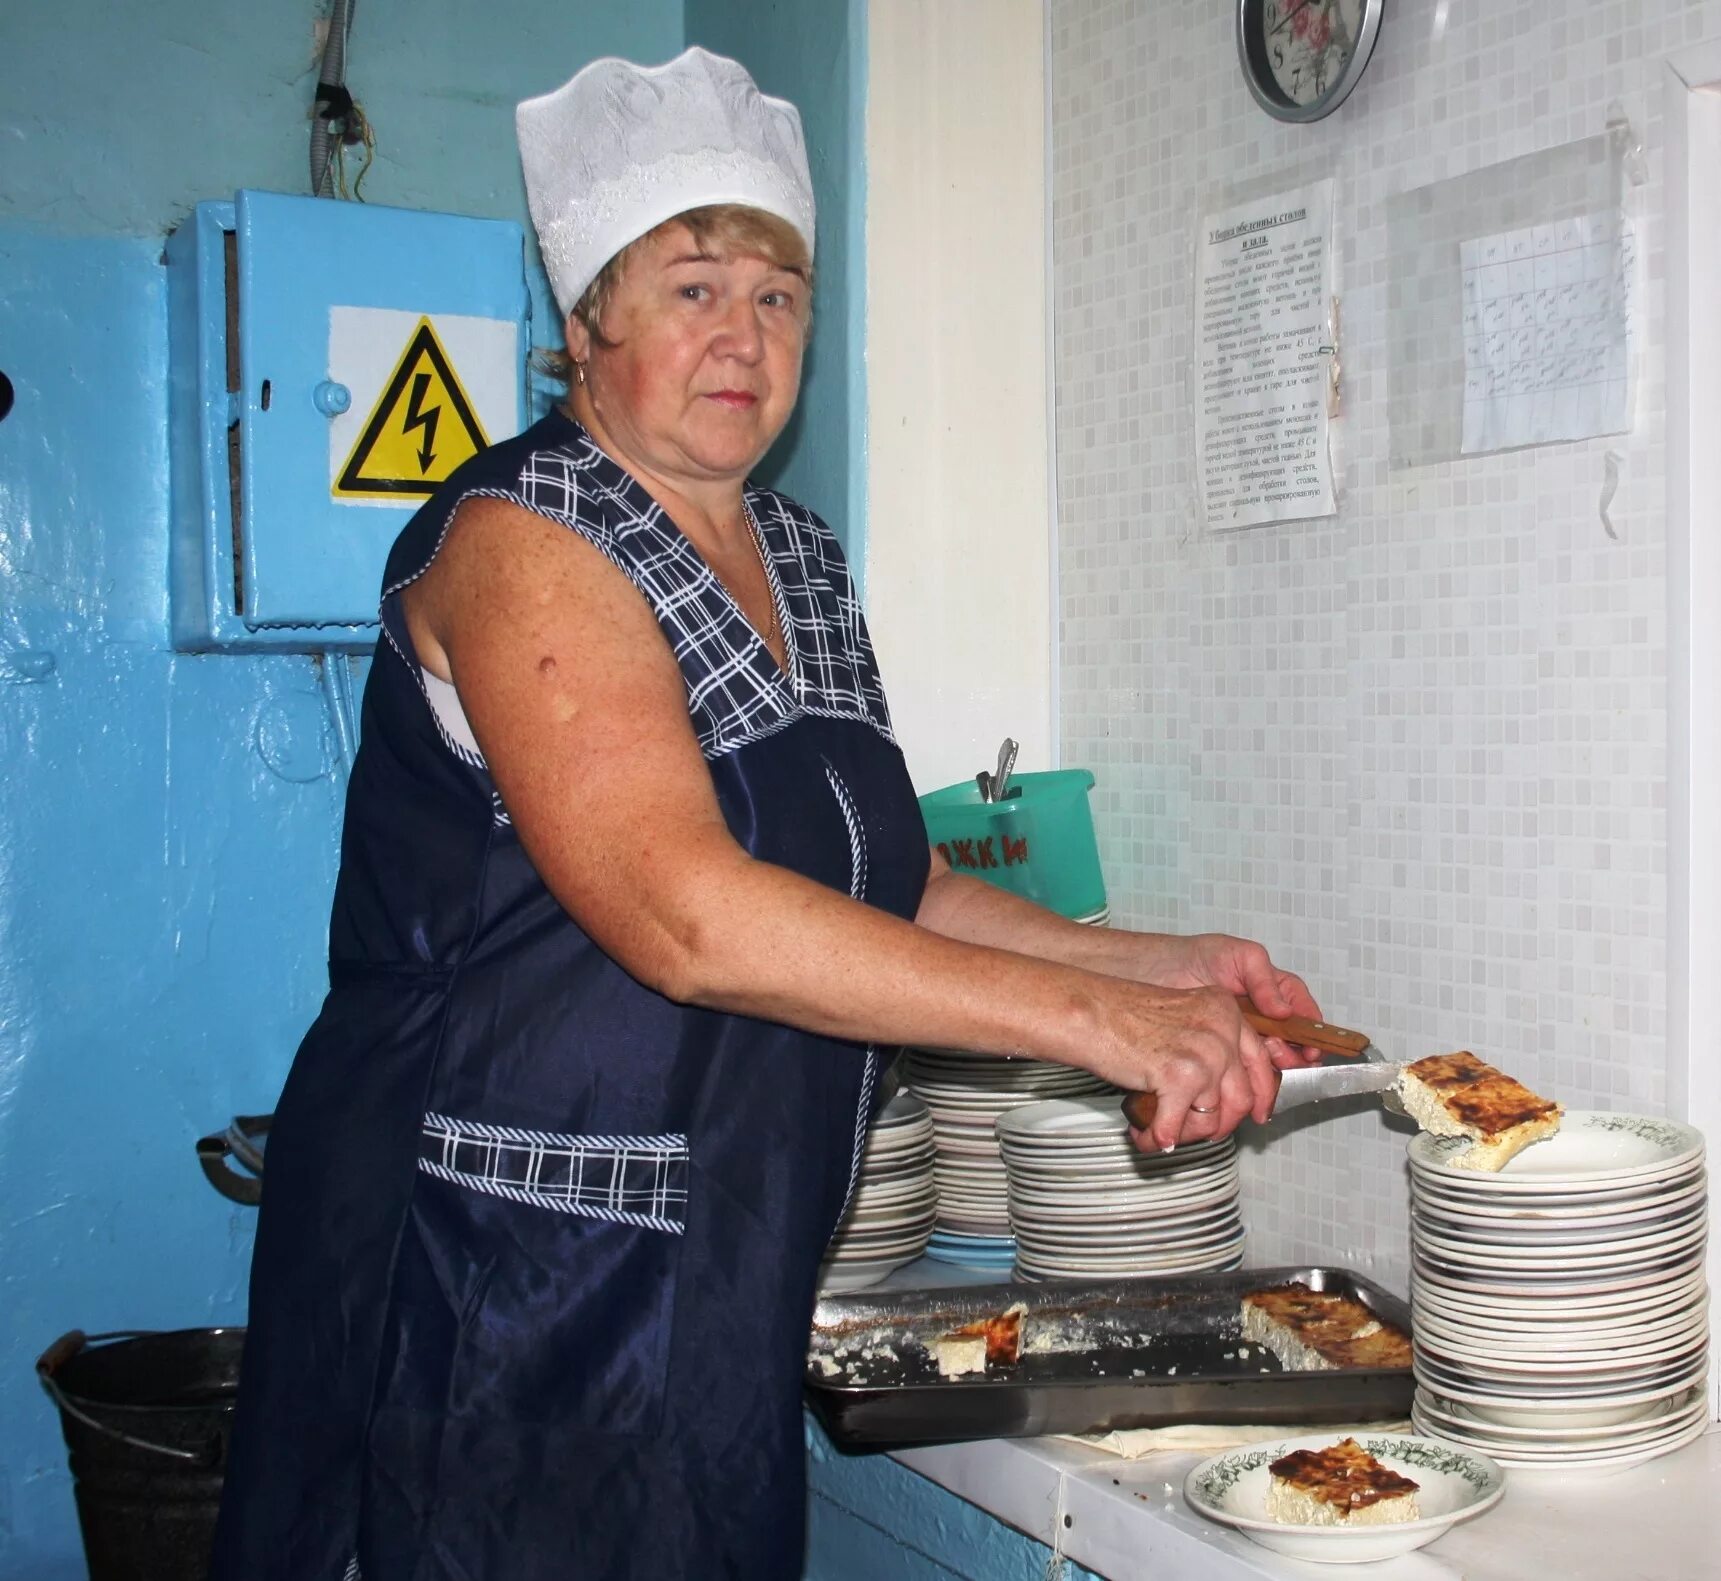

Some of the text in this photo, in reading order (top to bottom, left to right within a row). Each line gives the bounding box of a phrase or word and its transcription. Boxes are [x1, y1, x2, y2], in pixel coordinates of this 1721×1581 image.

[1274, 44, 1284, 70] 8
[1292, 67, 1301, 95] 7
[1279, 208, 1306, 222] столов
